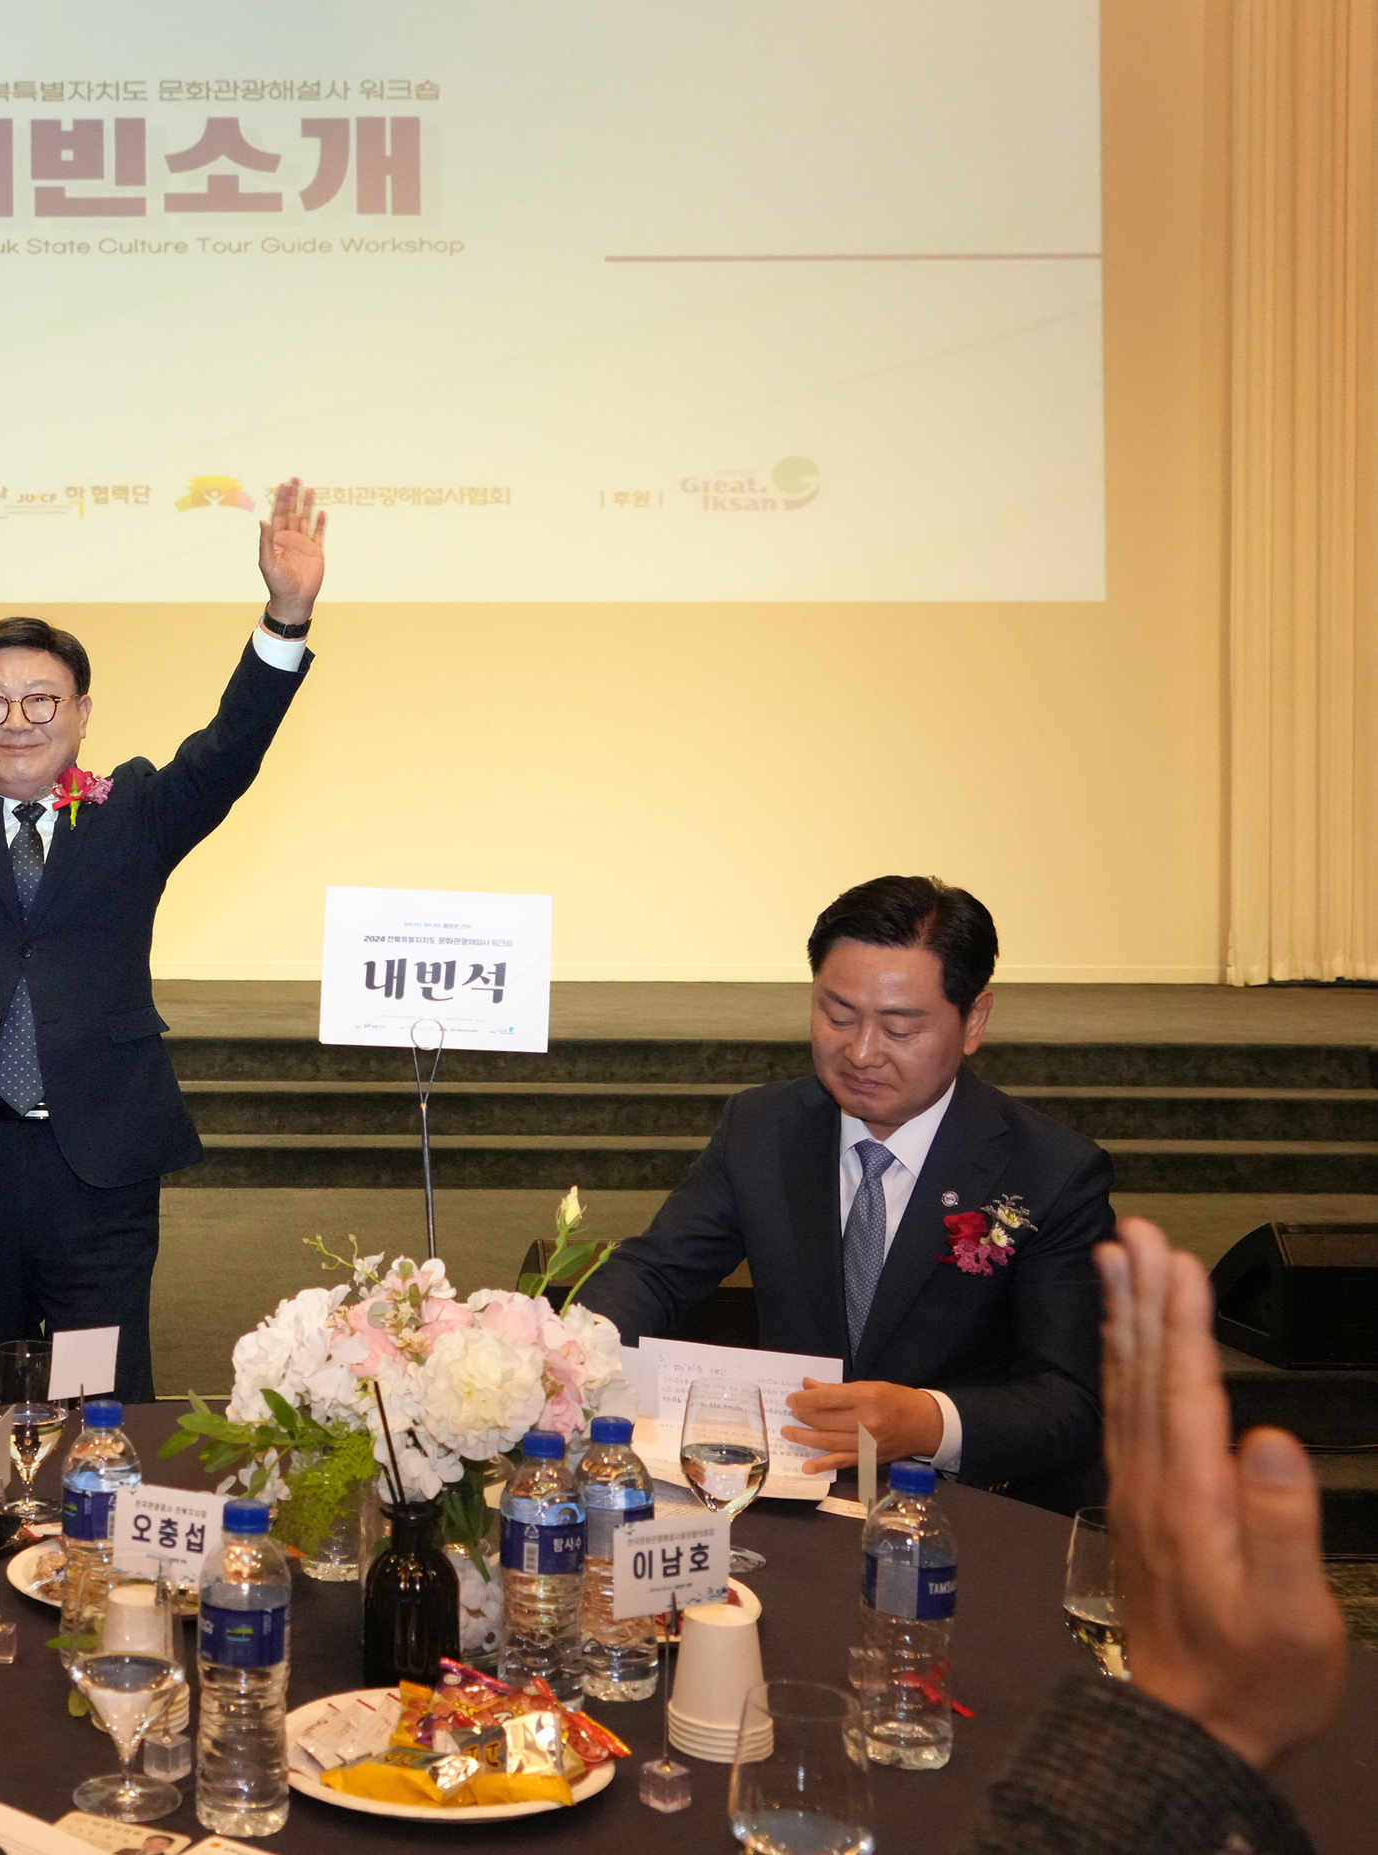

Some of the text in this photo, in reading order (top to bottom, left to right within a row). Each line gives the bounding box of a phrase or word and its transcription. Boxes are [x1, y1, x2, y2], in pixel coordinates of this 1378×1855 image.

[158, 79, 350, 102] 문화관광해설사
[358, 79, 441, 102] 워크숍
[26, 238, 91, 255] State
[98, 237, 189, 255] Culture
[195, 237, 251, 254] Tour
[260, 237, 333, 254] Guide
[340, 236, 466, 257] Workshop
[702, 495, 778, 512] Iksan
[363, 935, 386, 943] 2024
[363, 958, 507, 1005] 내빈석
[131, 1514, 206, 1555] 오충섭
[553, 1537, 582, 1553] 탐사수
[633, 1542, 710, 1580] 이남호
